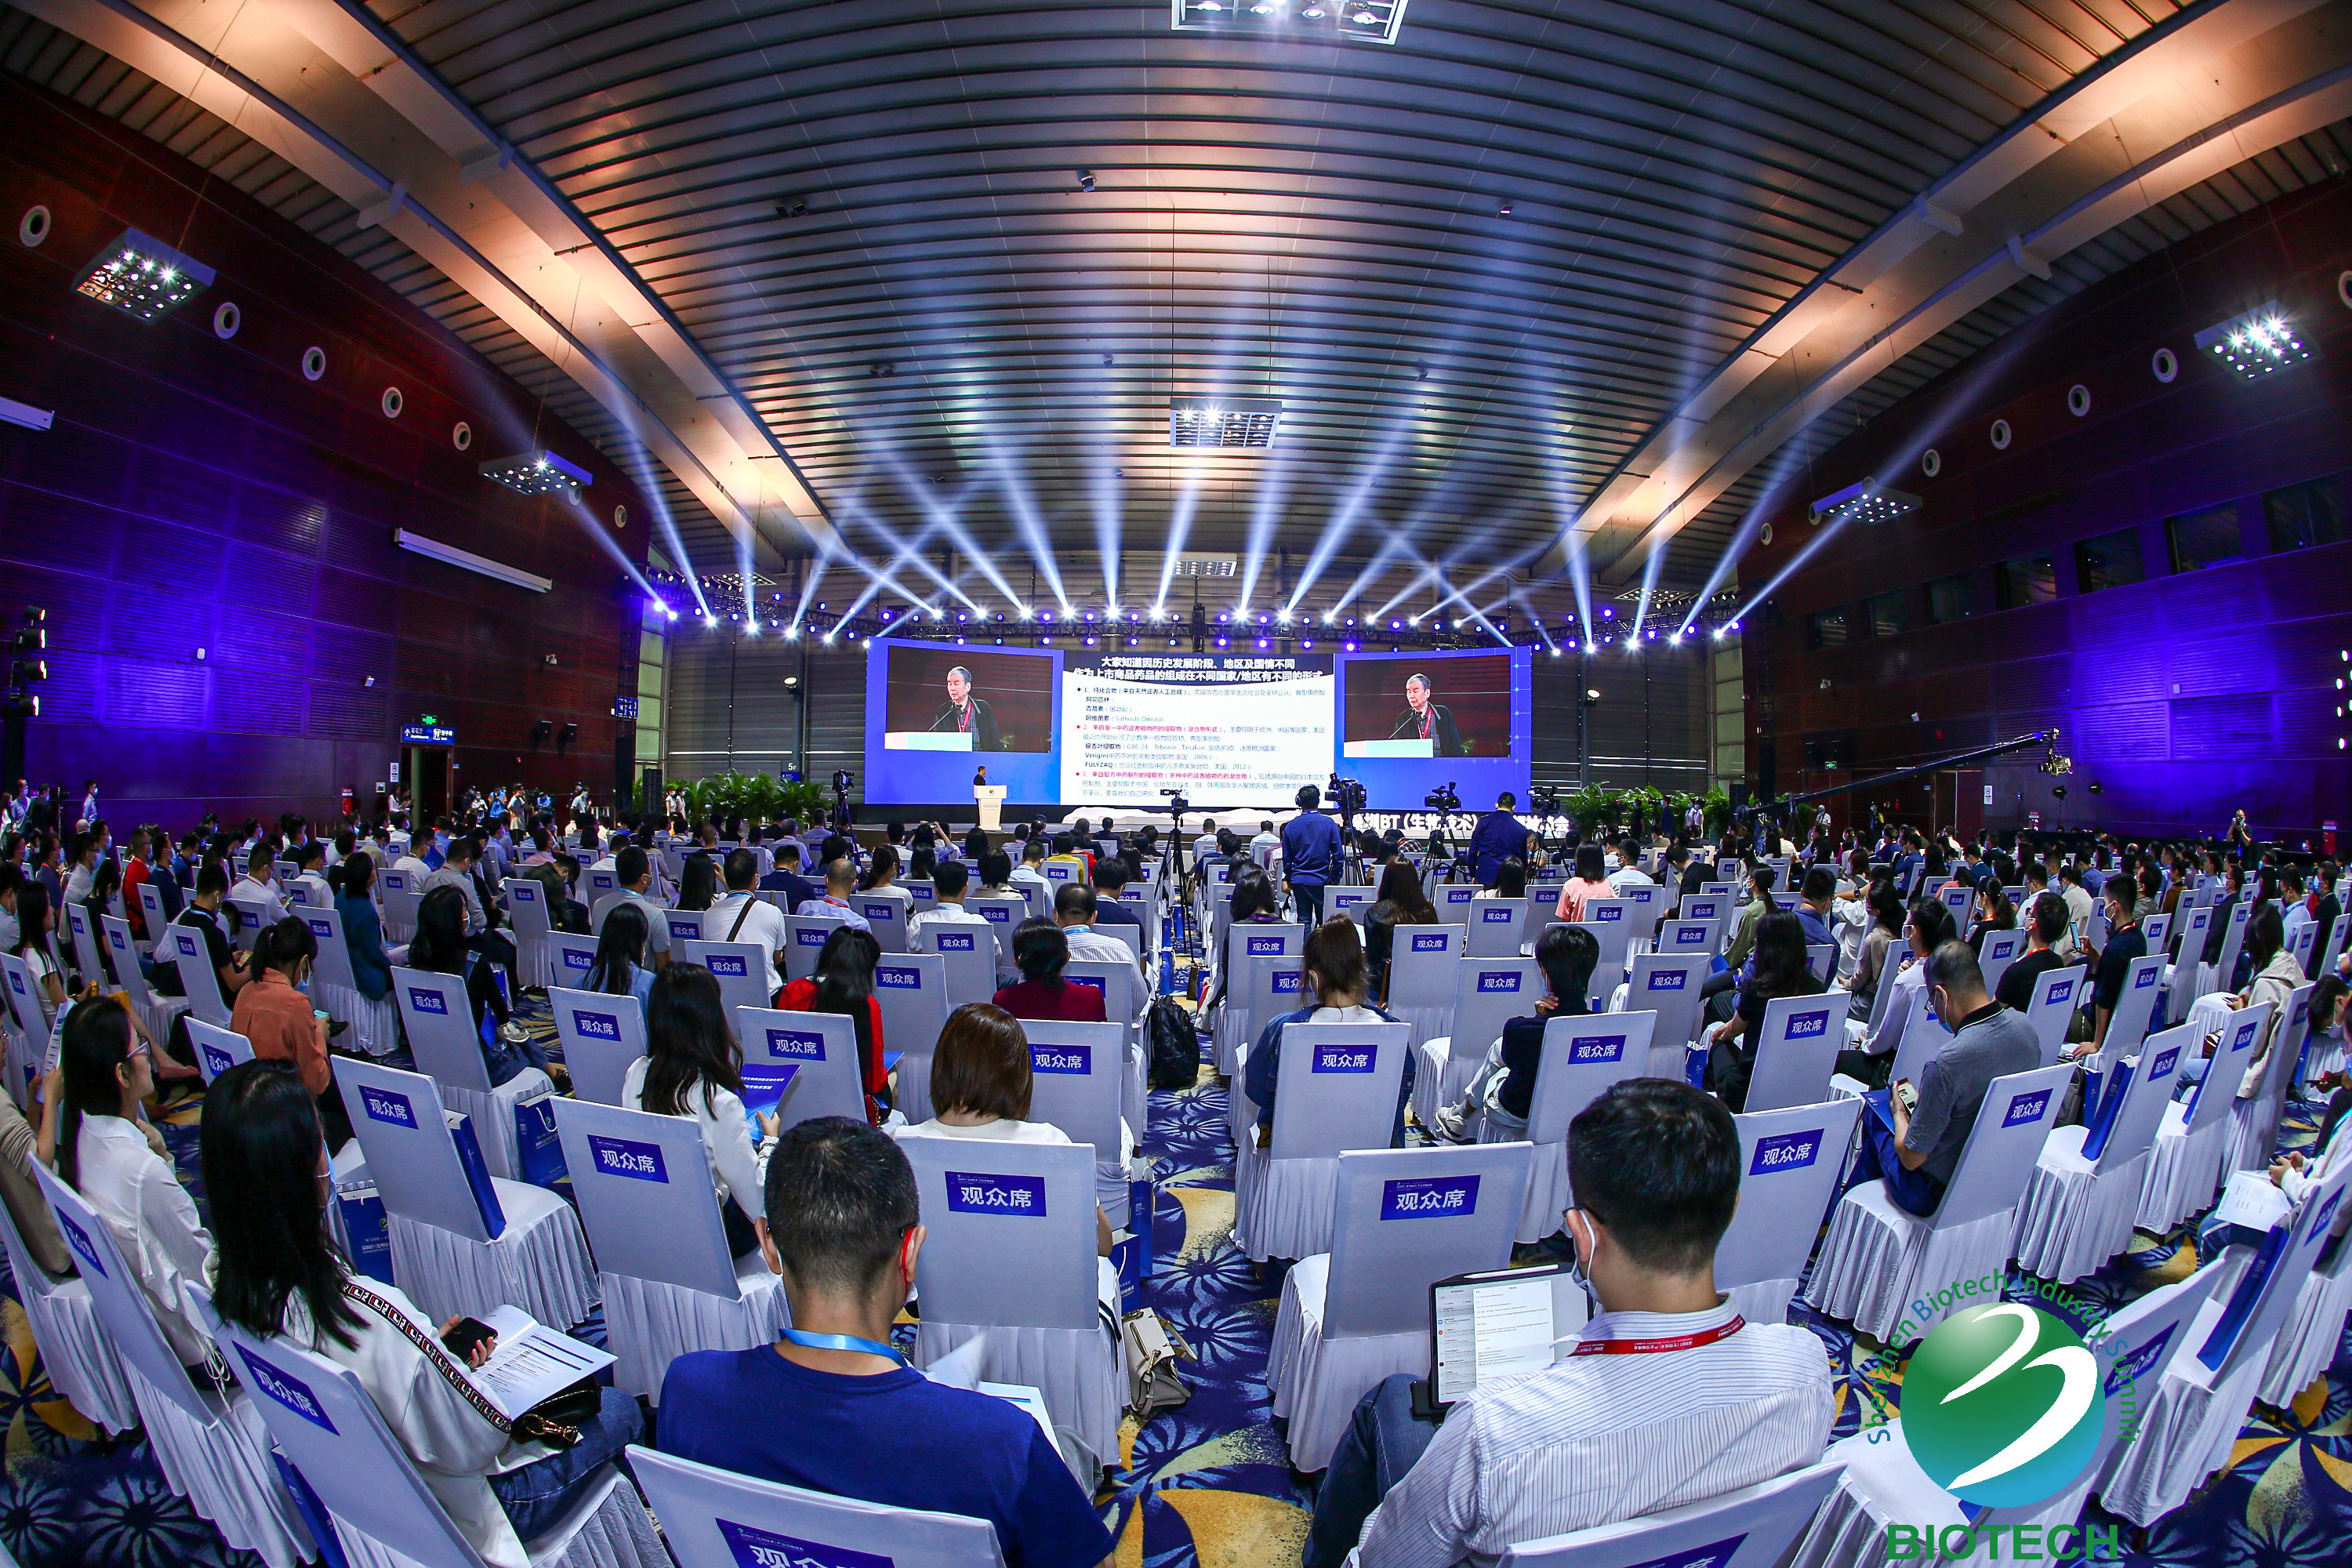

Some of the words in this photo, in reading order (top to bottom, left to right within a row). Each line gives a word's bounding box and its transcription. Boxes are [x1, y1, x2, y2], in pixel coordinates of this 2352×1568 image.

[674, 927, 696, 936] 观众席
[801, 934, 825, 943] 观众席
[1681, 932, 1702, 941] 观众席
[942, 938, 969, 948] 观众席
[1252, 942, 1280, 952] 观众席
[1417, 939, 1443, 949] 观众席
[712, 962, 741, 972] 观众席
[882, 973, 914, 985] 观众席
[1483, 978, 1515, 989] 观众席
[1654, 976, 1682, 986] 观众席
[581, 1020, 614, 1035] 观众席
[1791, 1019, 1823, 1033] 观众席
[775, 1039, 817, 1054] 观众席
[1577, 1044, 1617, 1058] 观众席
[1035, 1054, 1082, 1069] 观众席
[1322, 1054, 1369, 1068] 观众席
[368, 1099, 408, 1120] 观众席
[2010, 1101, 2042, 1120] 观众席
[601, 1150, 656, 1174] 观众席
[1762, 1143, 1812, 1167] 观众席
[961, 1186, 1032, 1208] 观众席
[1396, 1189, 1466, 1211] 观众席
[252, 1366, 318, 1417] 观众席
